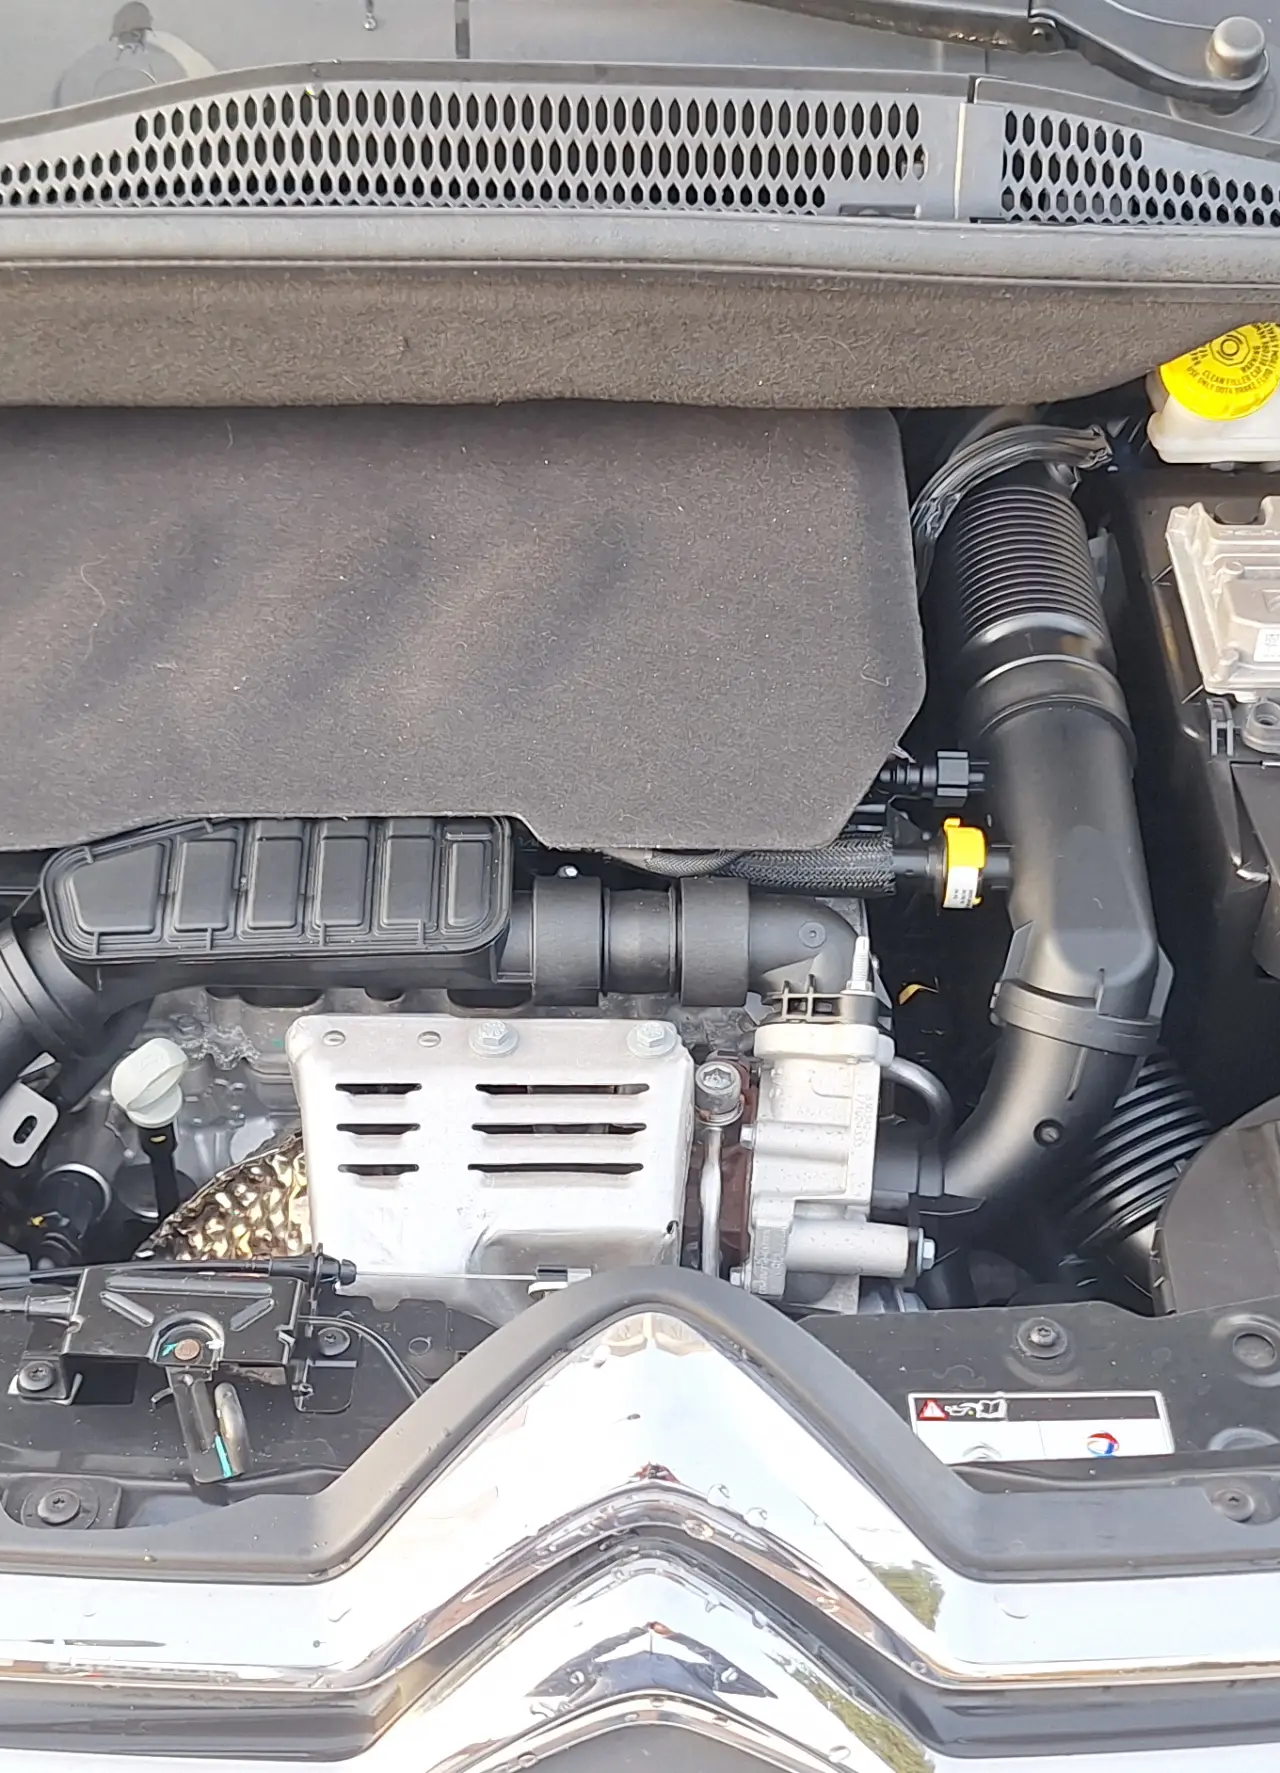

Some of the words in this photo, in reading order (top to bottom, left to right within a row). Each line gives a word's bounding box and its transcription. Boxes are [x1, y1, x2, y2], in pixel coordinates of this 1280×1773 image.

[1186, 366, 1200, 378] USE
[1197, 377, 1214, 390] ONLY
[1234, 382, 1256, 394] BRAKE
[1256, 368, 1273, 386] FLUID
[1267, 350, 1279, 368] FROM
[1202, 369, 1225, 384] CLEAN
[1226, 374, 1251, 386] FILLER
[1250, 365, 1262, 378] CAP
[1259, 341, 1270, 367] BEFORE
[1240, 345, 1261, 373] WARNING
